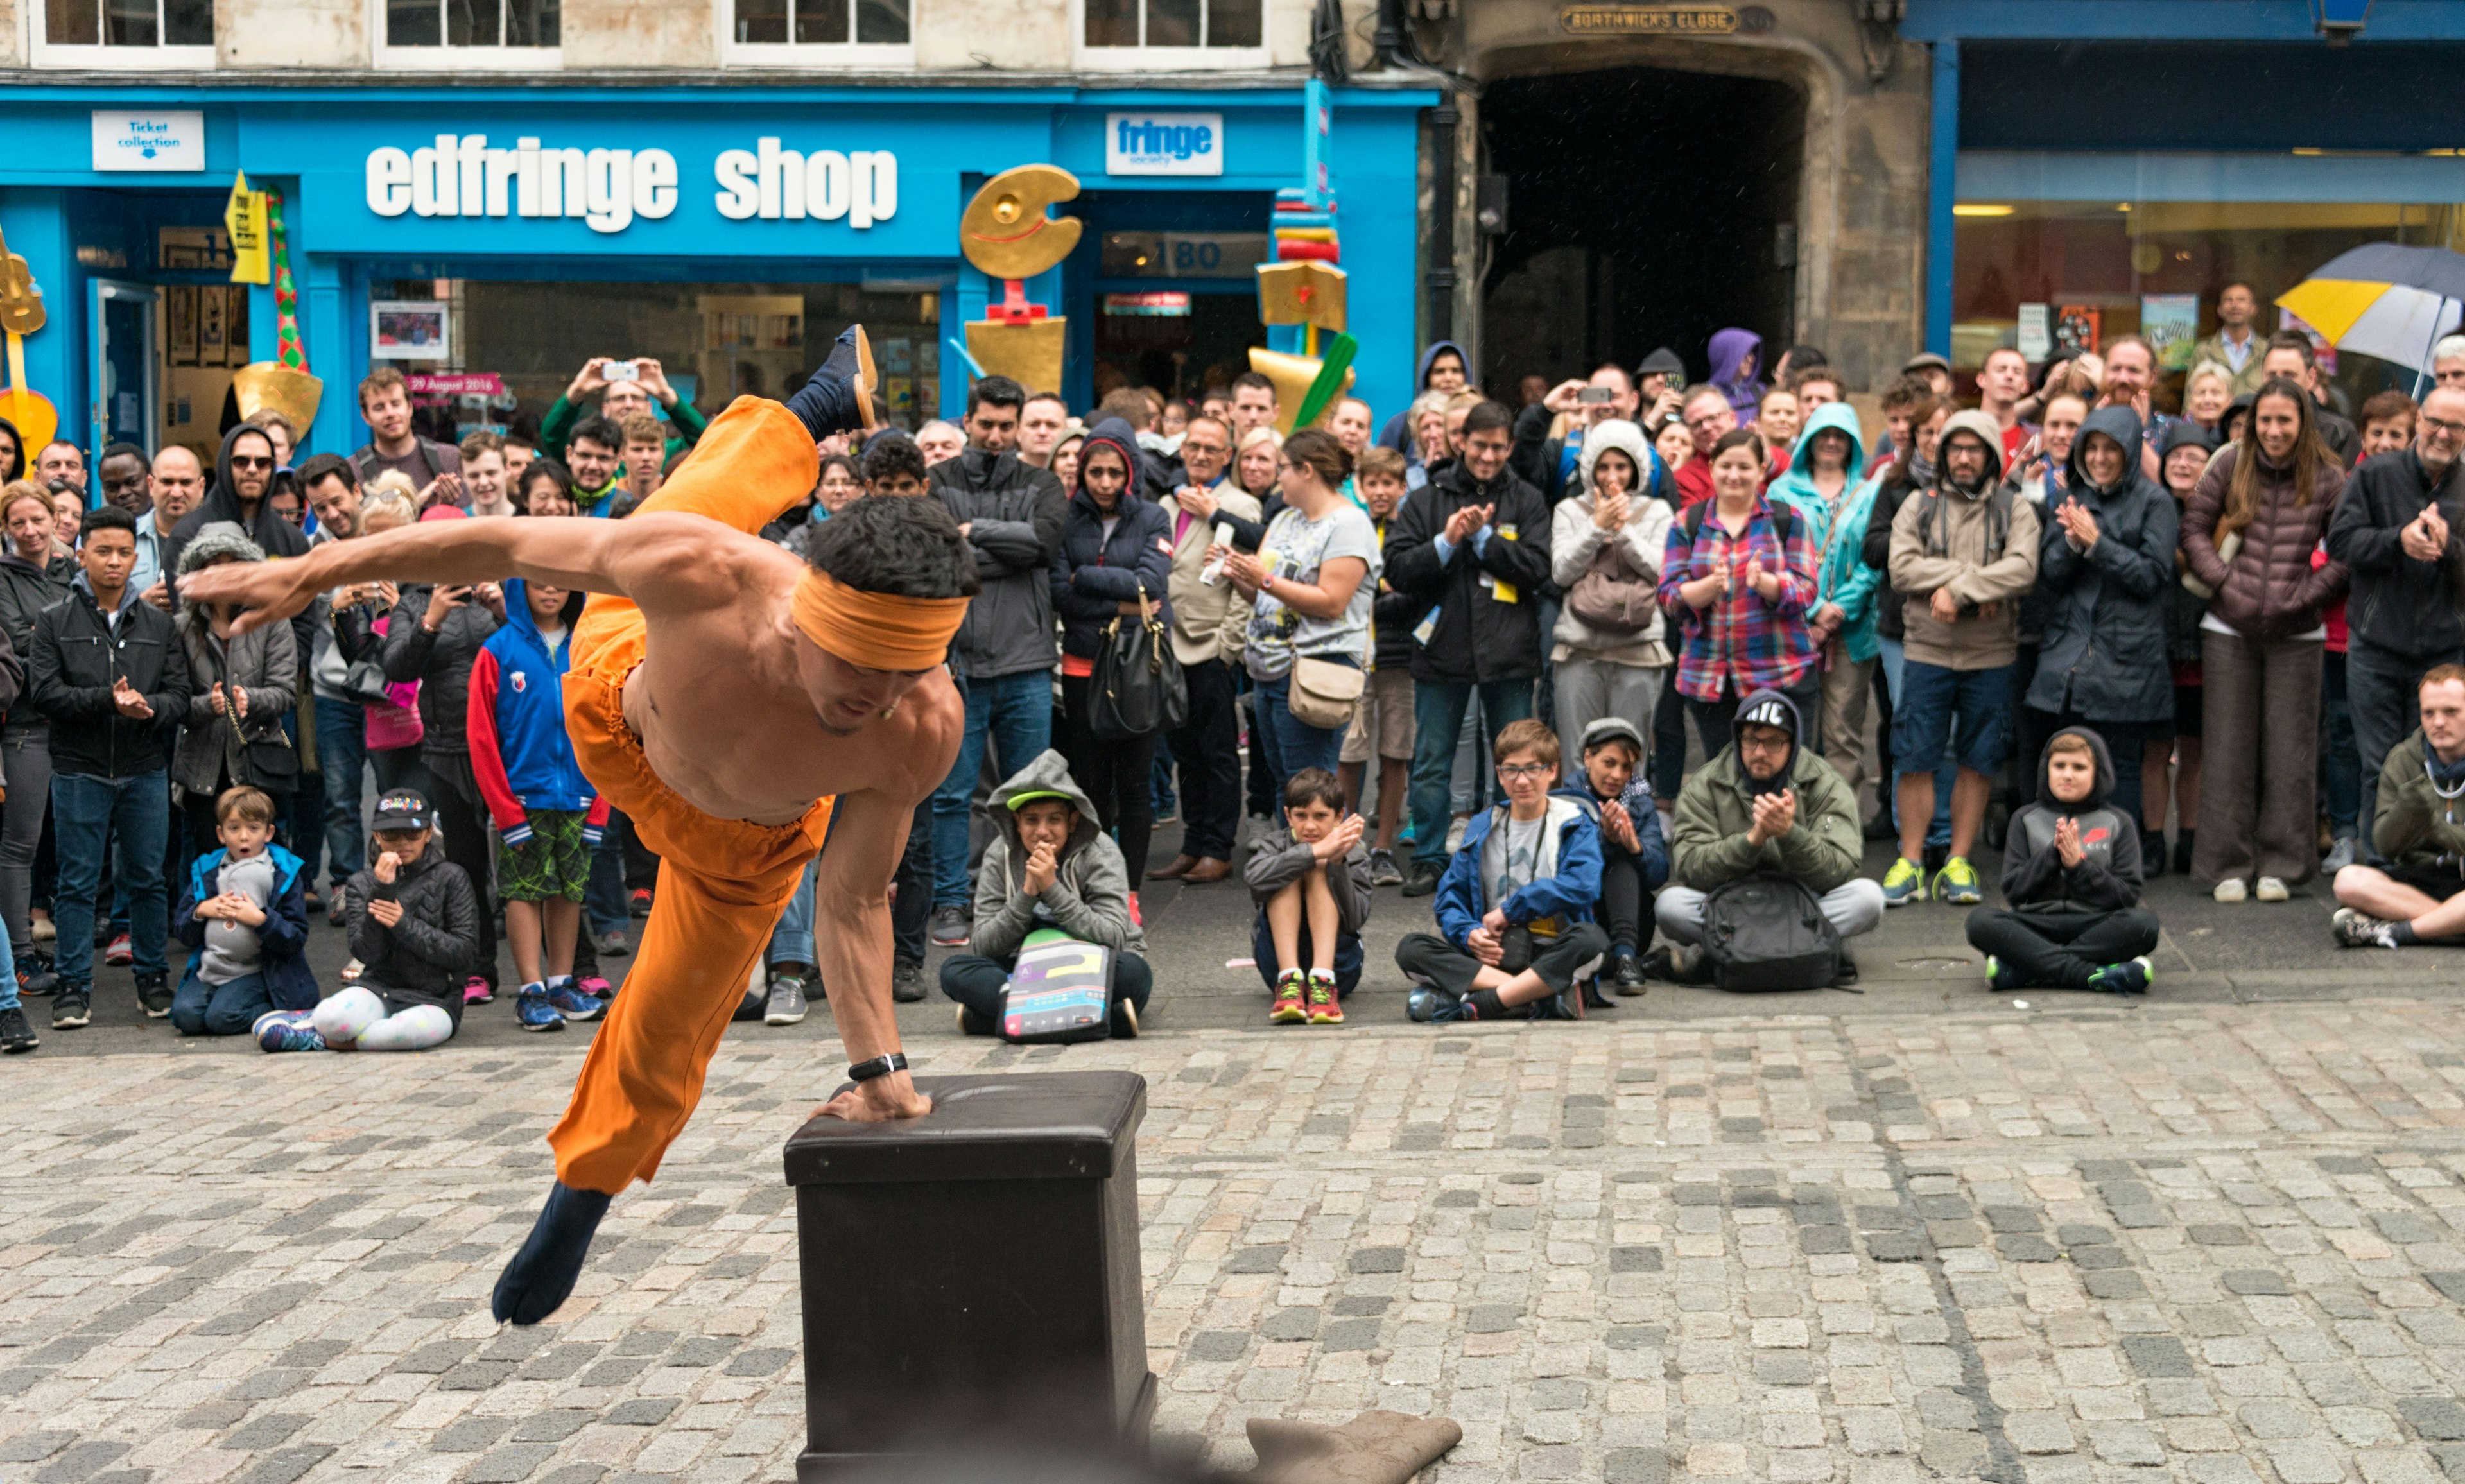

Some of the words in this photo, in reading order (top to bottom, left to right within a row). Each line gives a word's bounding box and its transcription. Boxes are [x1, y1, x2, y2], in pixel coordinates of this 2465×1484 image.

[1676, 13, 1727, 28] CLOSE
[130, 121, 168, 133] Ticket
[117, 136, 180, 147] collection
[1118, 119, 1212, 160] fringe
[365, 134, 679, 233] edfringe
[714, 136, 897, 229] shop
[1155, 241, 1220, 270] 180
[411, 377, 426, 390] 29
[427, 378, 464, 393] August
[466, 379, 493, 391] 2016
